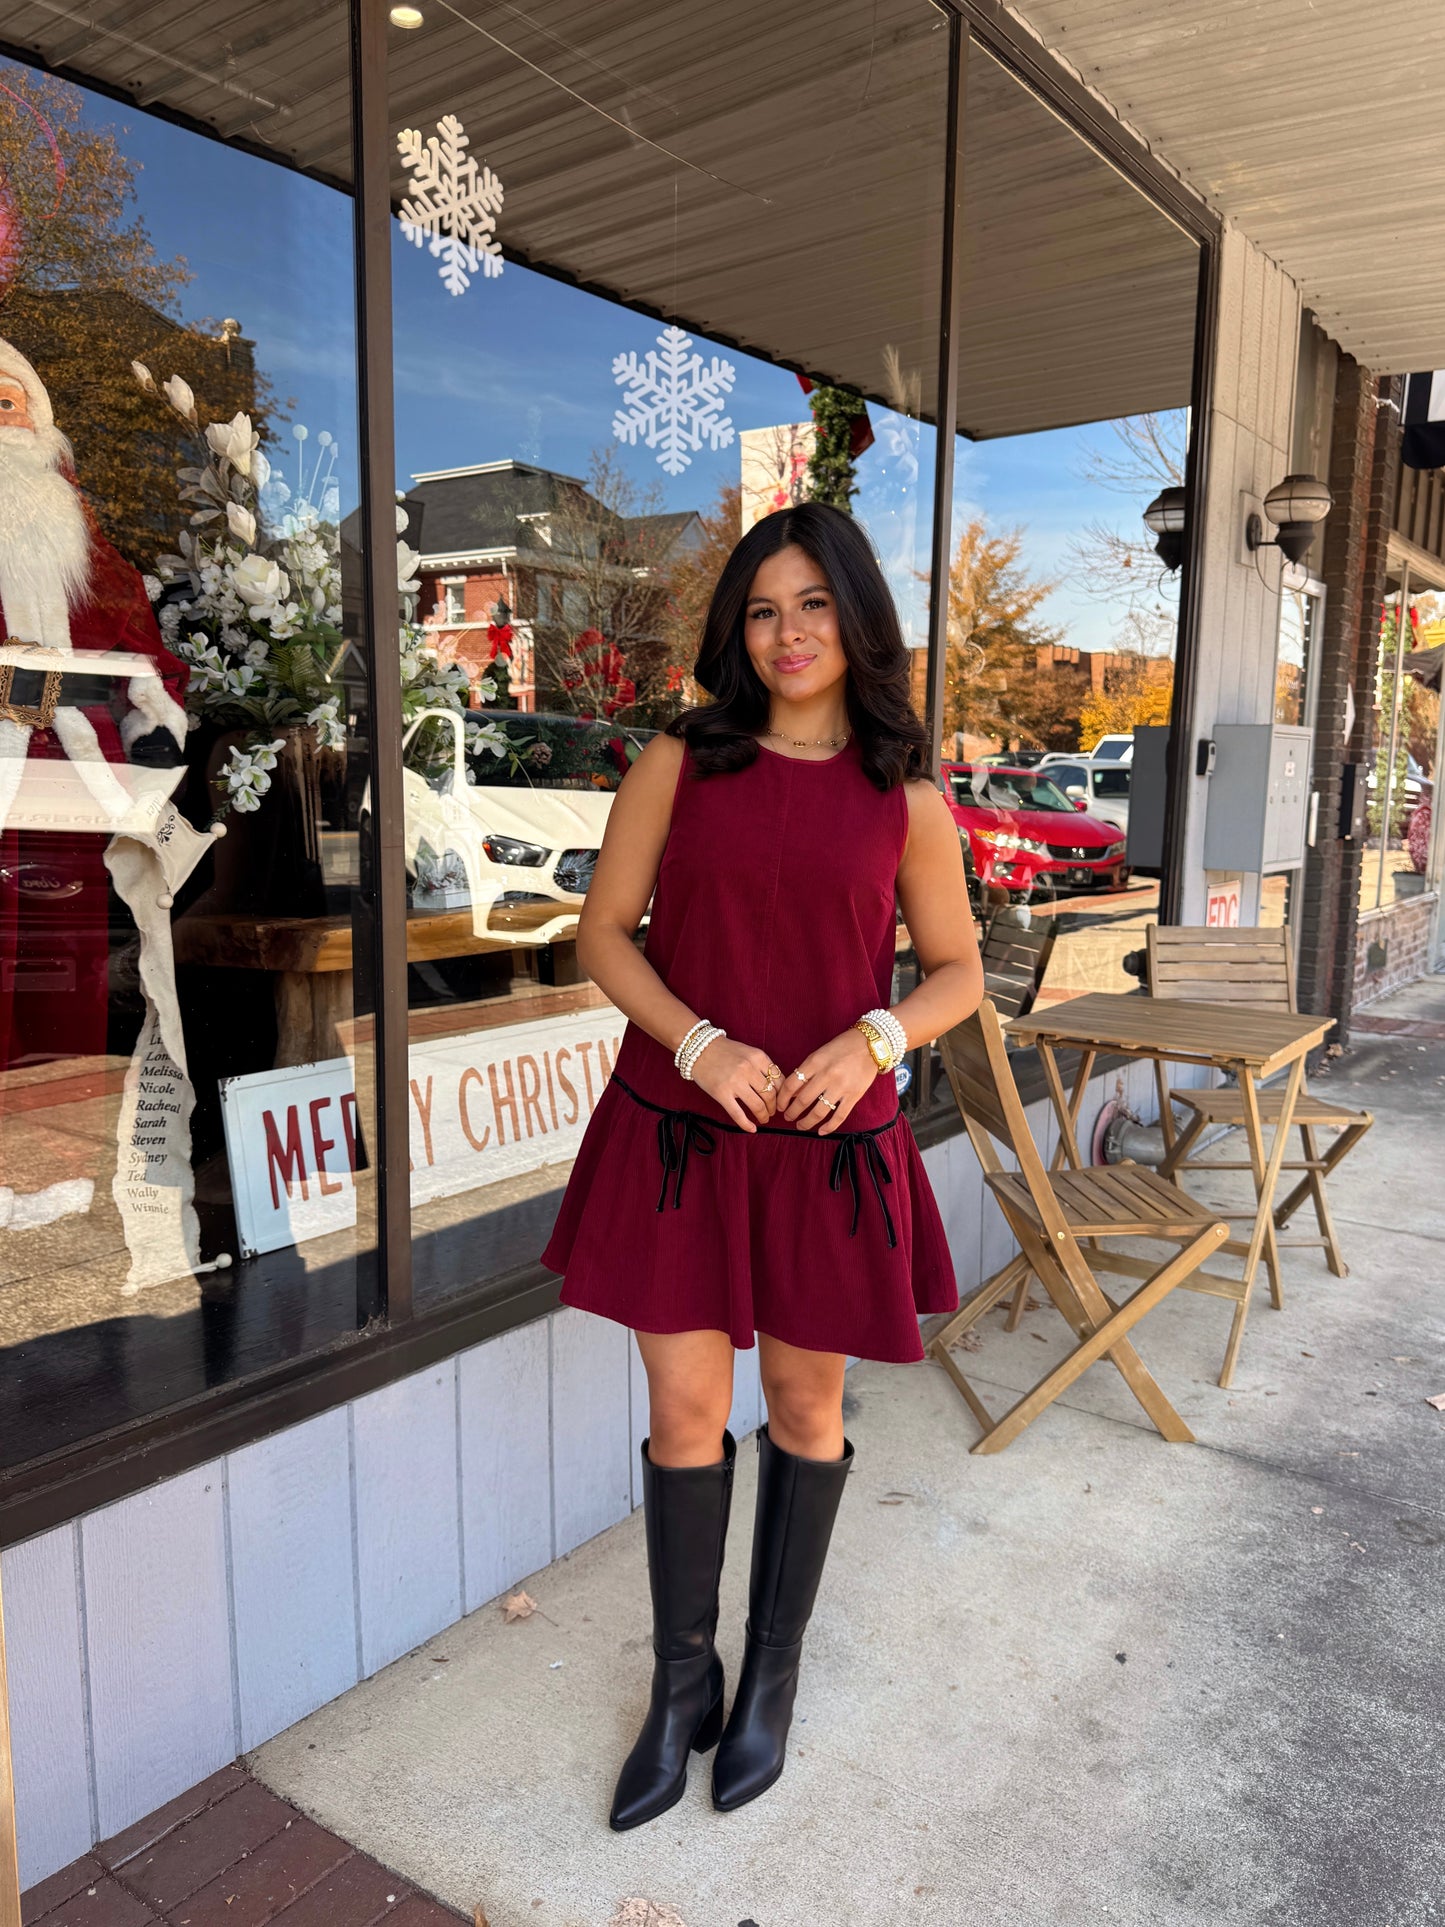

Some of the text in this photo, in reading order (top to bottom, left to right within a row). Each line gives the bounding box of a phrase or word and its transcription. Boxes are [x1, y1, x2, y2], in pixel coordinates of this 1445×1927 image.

[140, 1066, 184, 1081] Melissa
[138, 1082, 176, 1095] Nicole
[136, 1100, 180, 1114] Racheal
[133, 1118, 167, 1129] Sarah
[130, 1135, 166, 1146] Steven
[262, 1075, 434, 1210] MEY
[129, 1151, 168, 1166] Sydney
[128, 1170, 147, 1182] Ted
[127, 1187, 159, 1200] Wally
[132, 1203, 169, 1215] Winnie
